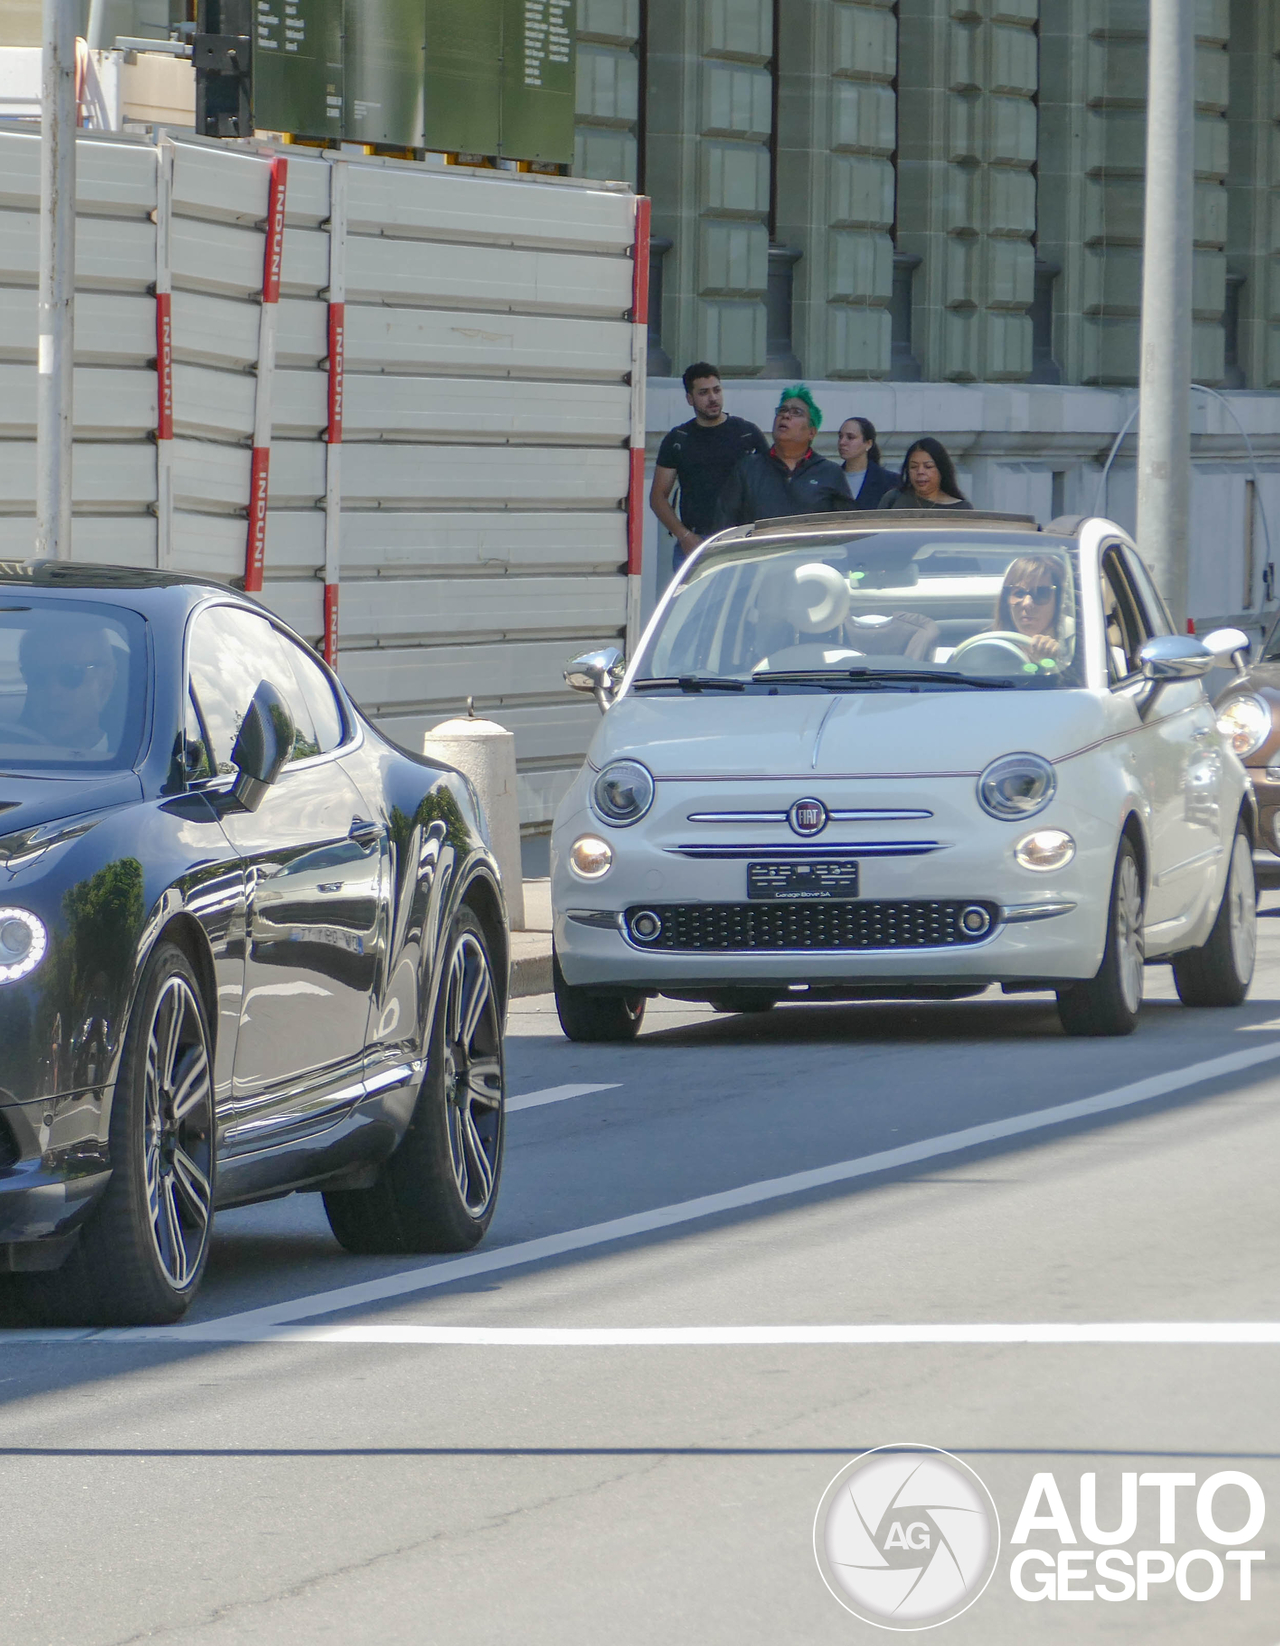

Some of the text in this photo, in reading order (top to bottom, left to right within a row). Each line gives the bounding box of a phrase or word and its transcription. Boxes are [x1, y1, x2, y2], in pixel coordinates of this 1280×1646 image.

[271, 185, 285, 281] INDUNI
[163, 317, 171, 415] INDUNI
[335, 327, 343, 420] INDUNI
[254, 472, 267, 568] INDUNI
[798, 809, 819, 825] FIAT
